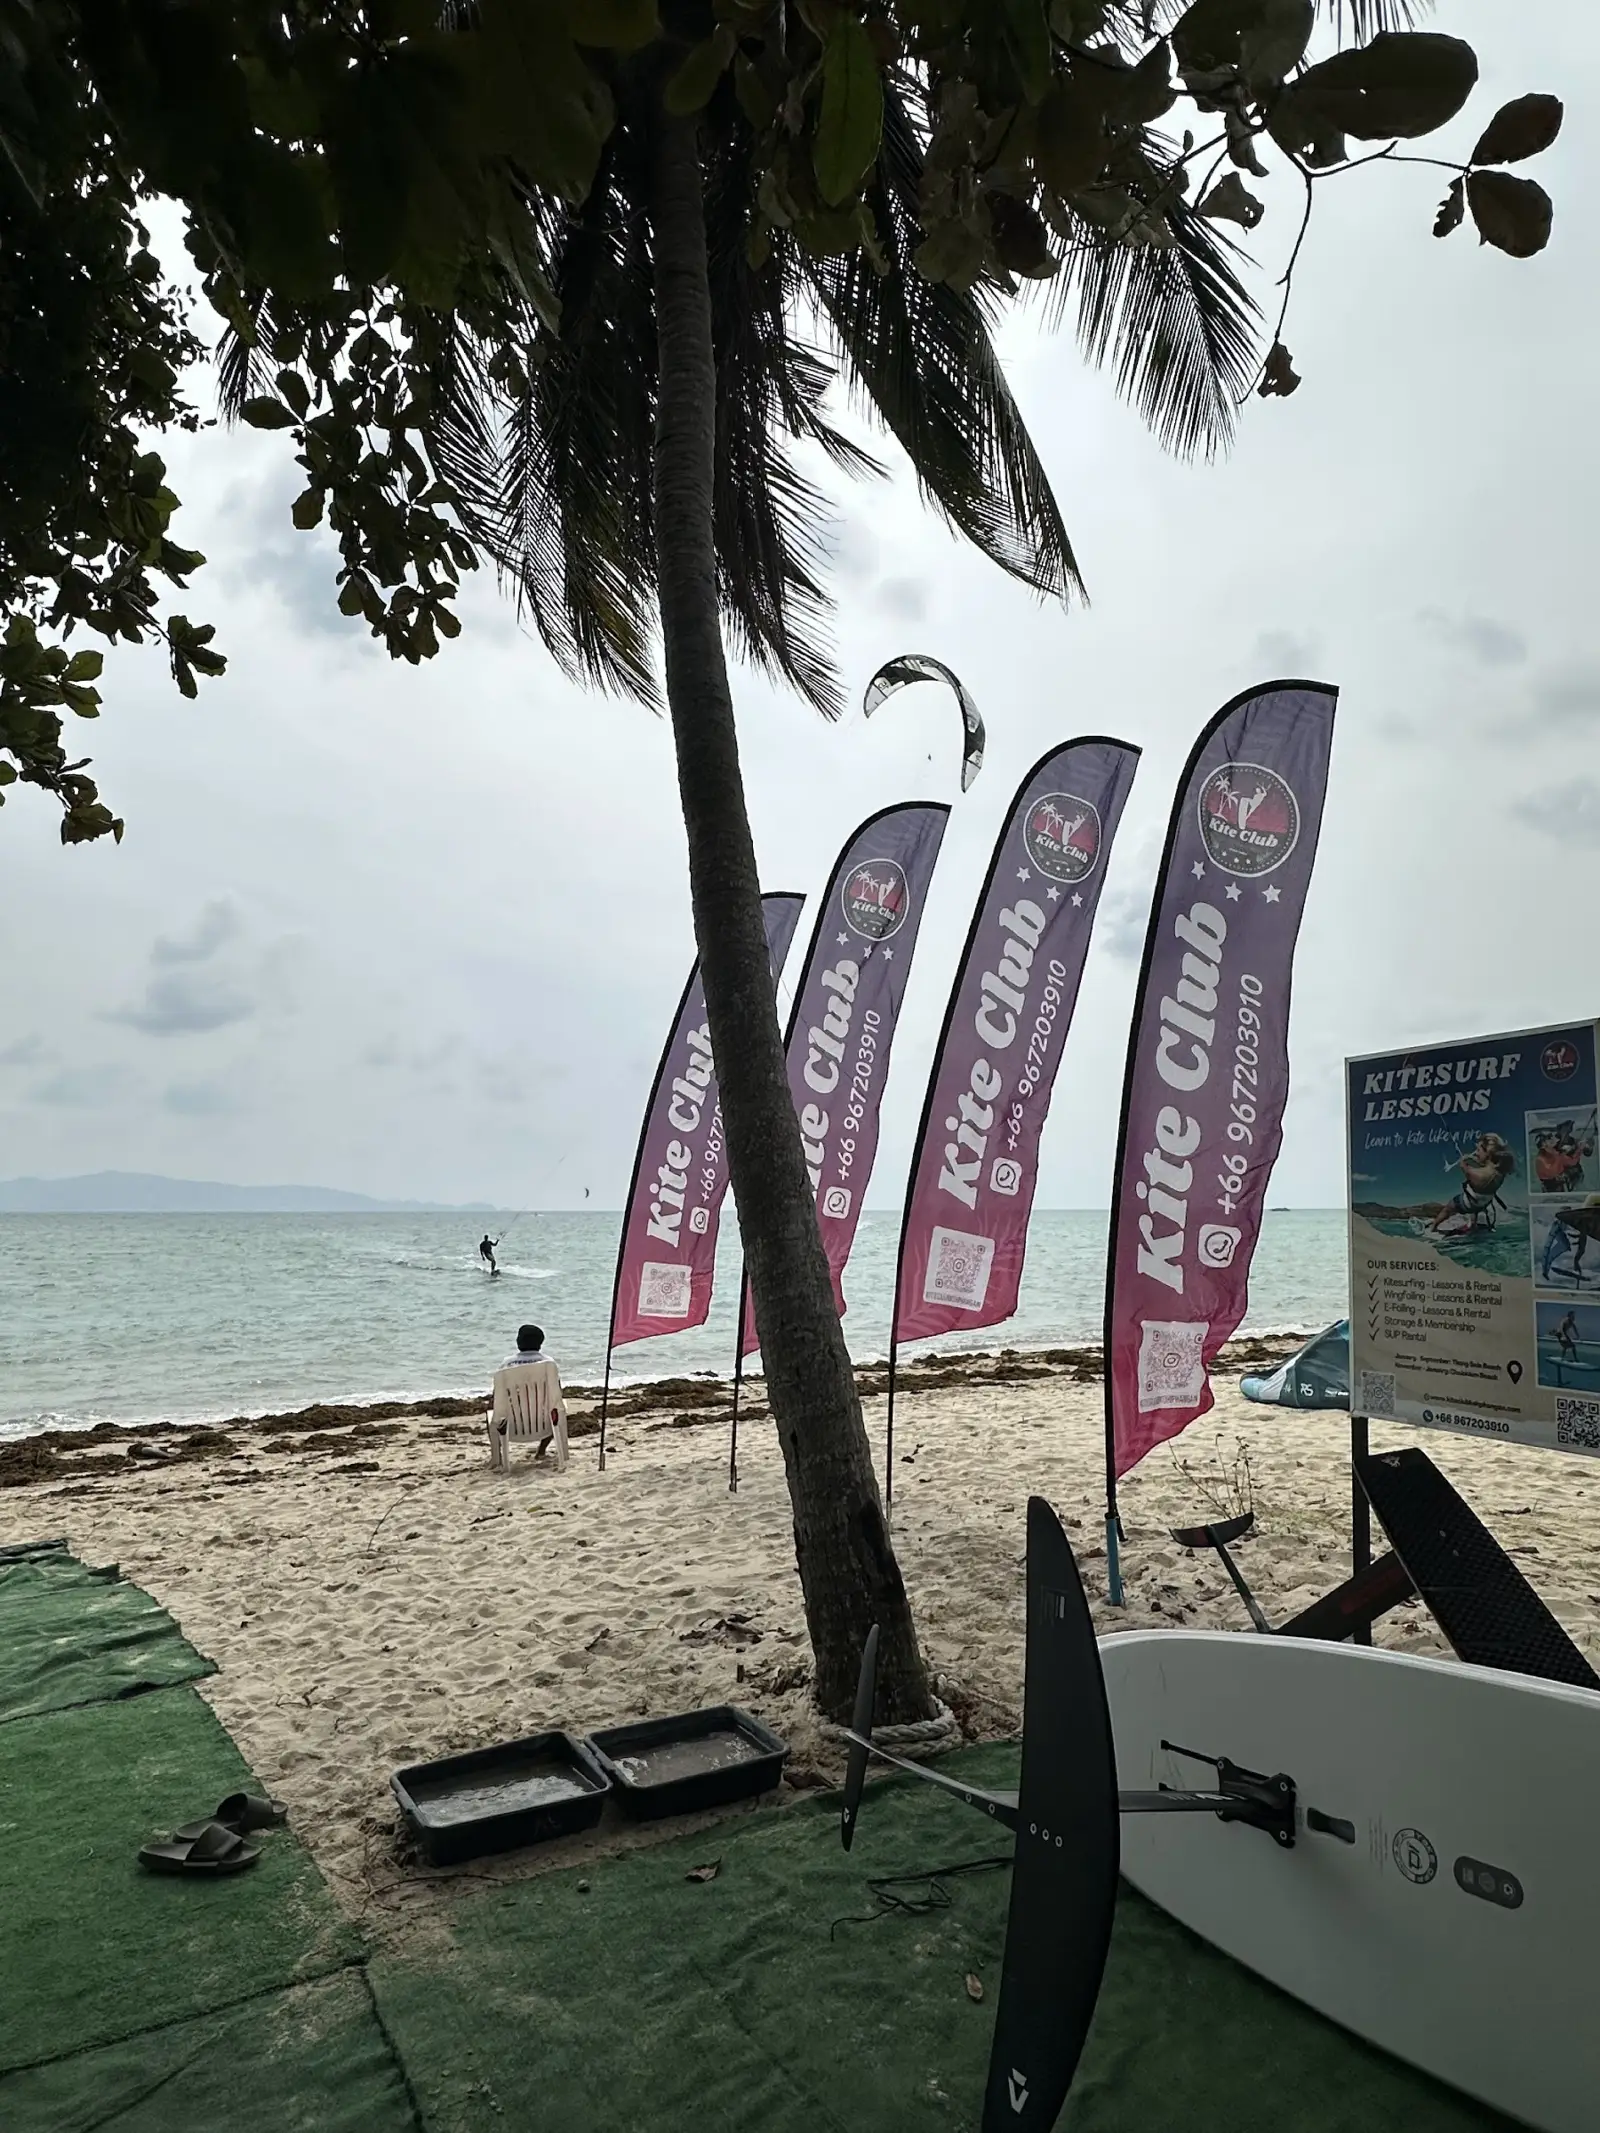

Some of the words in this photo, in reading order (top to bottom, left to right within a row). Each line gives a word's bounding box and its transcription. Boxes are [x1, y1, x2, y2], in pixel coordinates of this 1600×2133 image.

[1035, 834, 1061, 852] Kite
[1062, 845, 1088, 863] Club
[1209, 817, 1238, 838] Kite
[1239, 830, 1279, 847] Club
[852, 900, 877, 913] Kite
[1156, 901, 1227, 1092] Club
[803, 958, 861, 1094] Club
[843, 1009, 882, 1132] 967203910
[938, 1058, 1002, 1211] Kite
[975, 899, 1046, 1050] Club
[1006, 1102, 1024, 1152] +66
[1018, 959, 1068, 1098] 967203910
[1227, 973, 1263, 1146] 967203910
[1362, 1053, 1521, 1095] KITESURF
[1363, 1088, 1491, 1122] LESSONS
[1364, 1132, 1391, 1150] Learn
[1394, 1132, 1403, 1147] to
[1429, 1127, 1449, 1144] like
[1462, 1128, 1482, 1144] pro
[838, 1138, 855, 1181] +66
[646, 1139, 692, 1248] Kite
[700, 1167, 716, 1203] +66
[1136, 1105, 1202, 1295] Kite
[1217, 1153, 1248, 1215] +66
[1367, 1259, 1387, 1270] OUR
[1390, 1260, 1440, 1272] SERVICES:
[1383, 1277, 1425, 1291] Kitesurfing
[1432, 1279, 1464, 1291] Lessons
[1465, 1281, 1472, 1291] &
[1474, 1280, 1502, 1293] Rental
[1432, 1292, 1465, 1304] Lessons
[1466, 1294, 1473, 1304] &
[1474, 1294, 1503, 1306] Rental
[1384, 1315, 1416, 1328] Storage
[1417, 1318, 1423, 1328] &
[1425, 1318, 1476, 1334] Membership
[1422, 1305, 1454, 1317] Lessons
[1456, 1307, 1462, 1317] &
[1464, 1307, 1492, 1319] Rental
[1402, 1331, 1427, 1342] Rental
[1435, 1413, 1452, 1424] +66
[1453, 1415, 1510, 1433] 967203910
